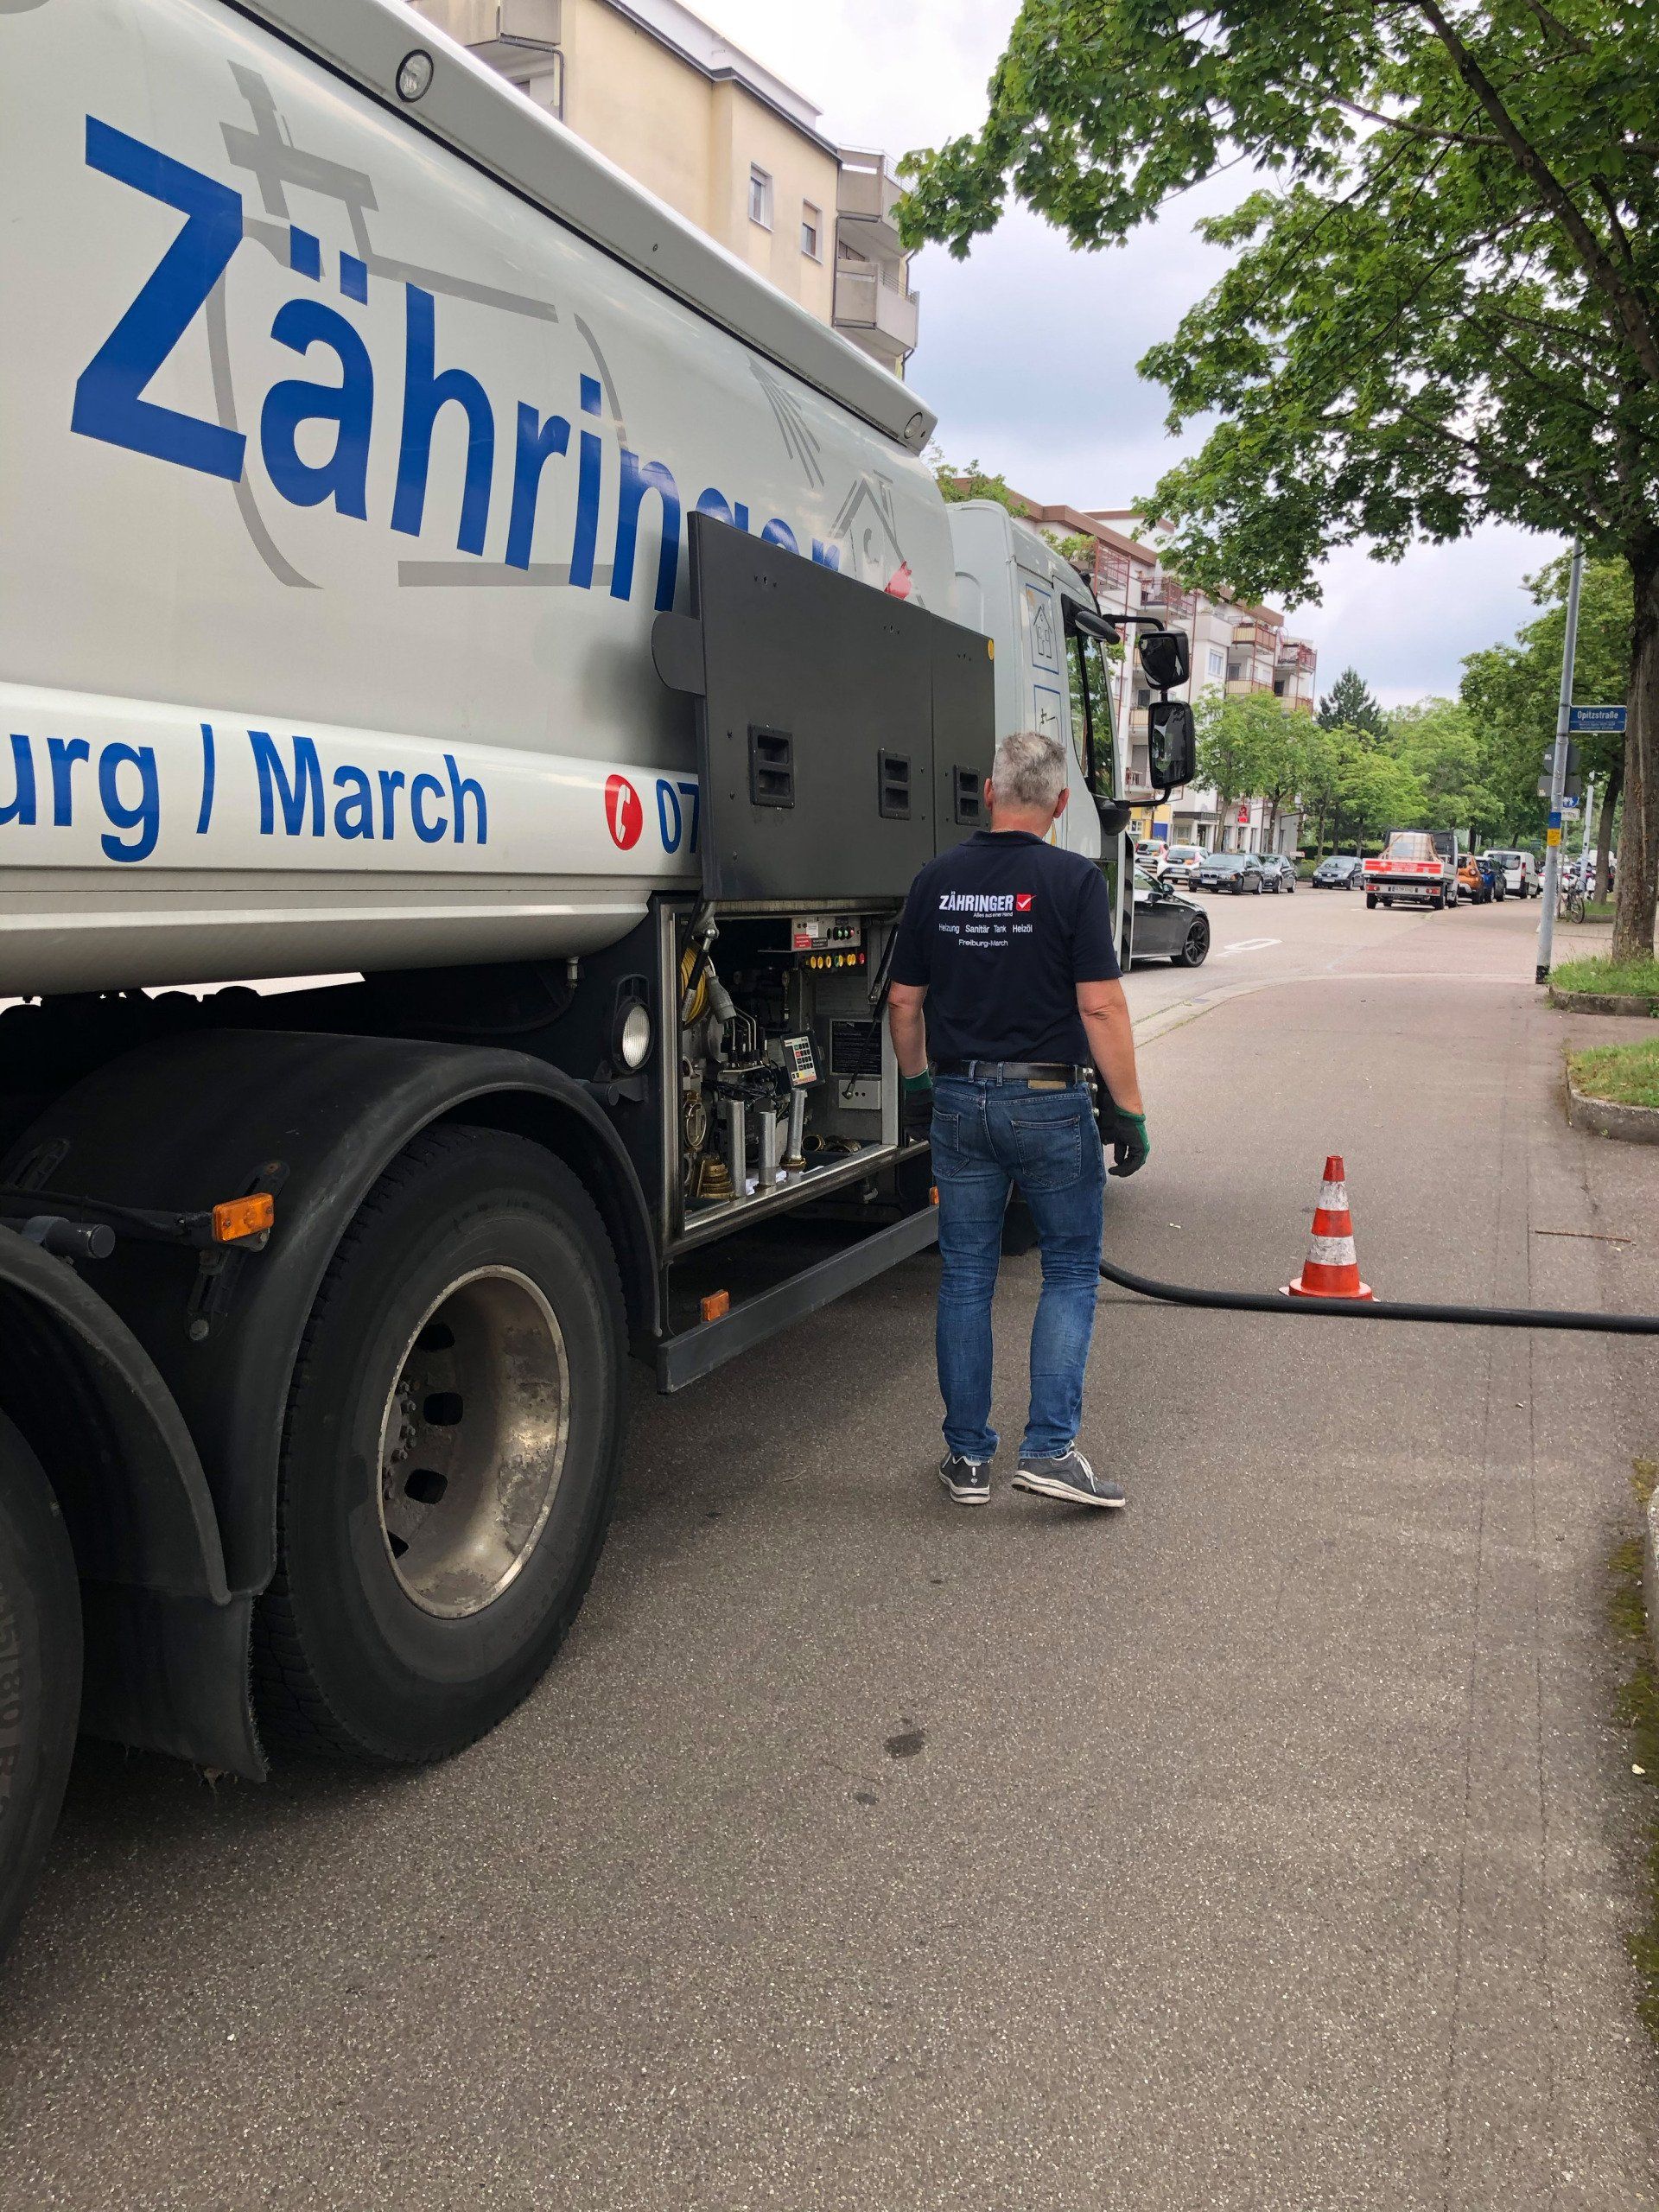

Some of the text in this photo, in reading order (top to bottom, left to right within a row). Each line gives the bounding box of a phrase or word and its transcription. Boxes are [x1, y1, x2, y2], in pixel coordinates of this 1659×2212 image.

[1577, 710, 1619, 721] Opitzstraße
[247, 730, 486, 845] March
[938, 891, 1014, 912] ZÄHRINGER
[938, 923, 1033, 934] Heizung Sanitär Tank Heizöl
[958, 938, 1008, 948] Freiburg-March
